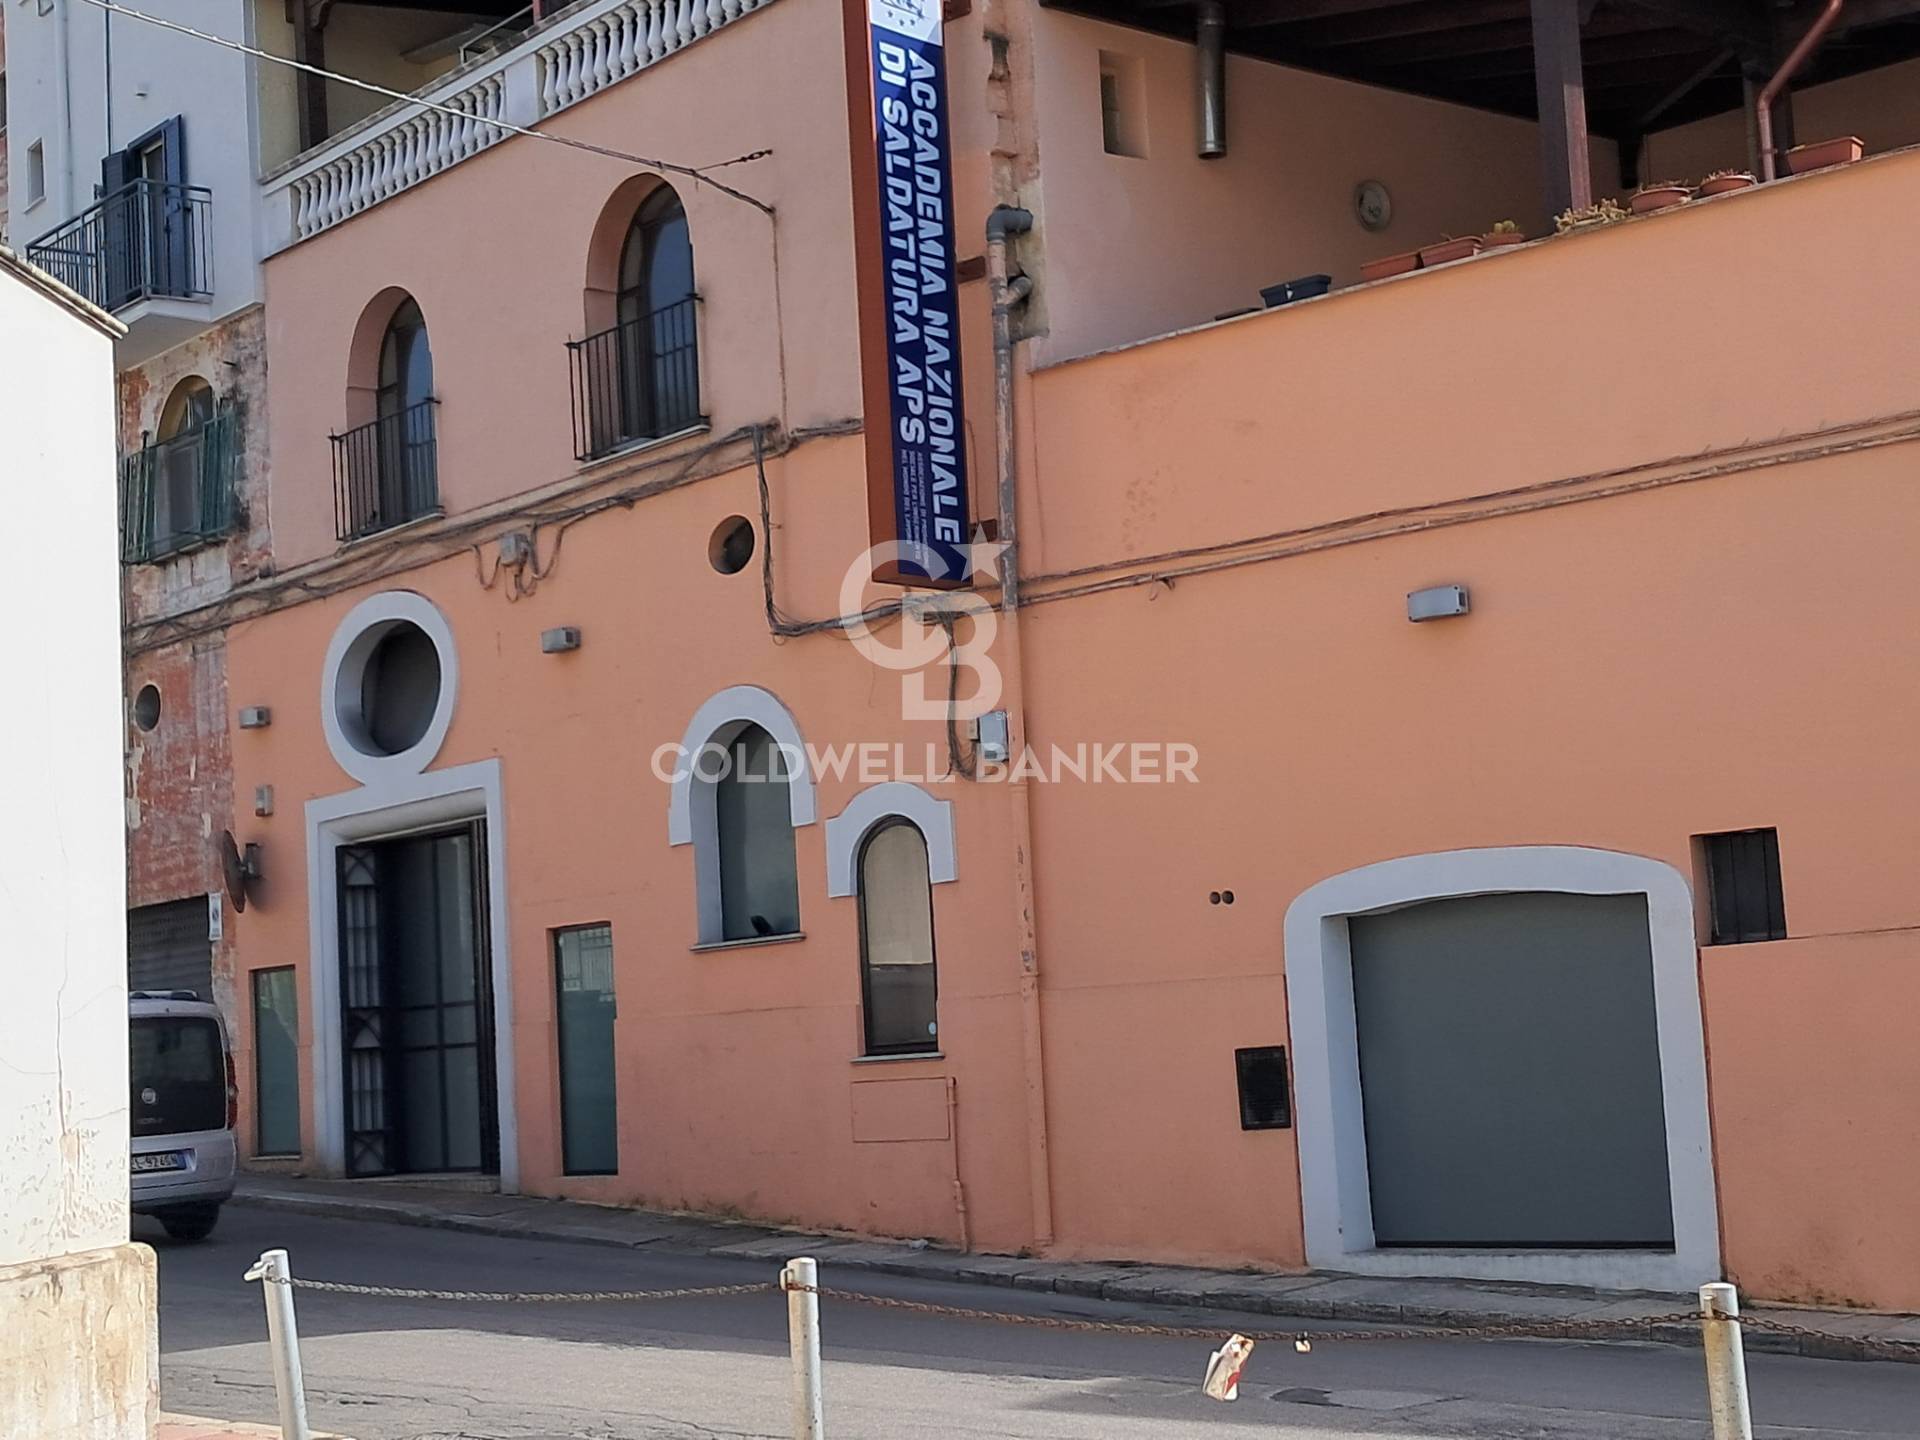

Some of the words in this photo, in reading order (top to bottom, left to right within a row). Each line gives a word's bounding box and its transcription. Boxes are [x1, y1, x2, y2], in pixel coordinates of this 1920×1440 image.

[879, 41, 907, 88] DI
[908, 48, 947, 295] ACCADEMIA
[883, 97, 920, 344] SALDATURA
[896, 354, 926, 445] APS
[923, 308, 960, 543] NAZIONALE
